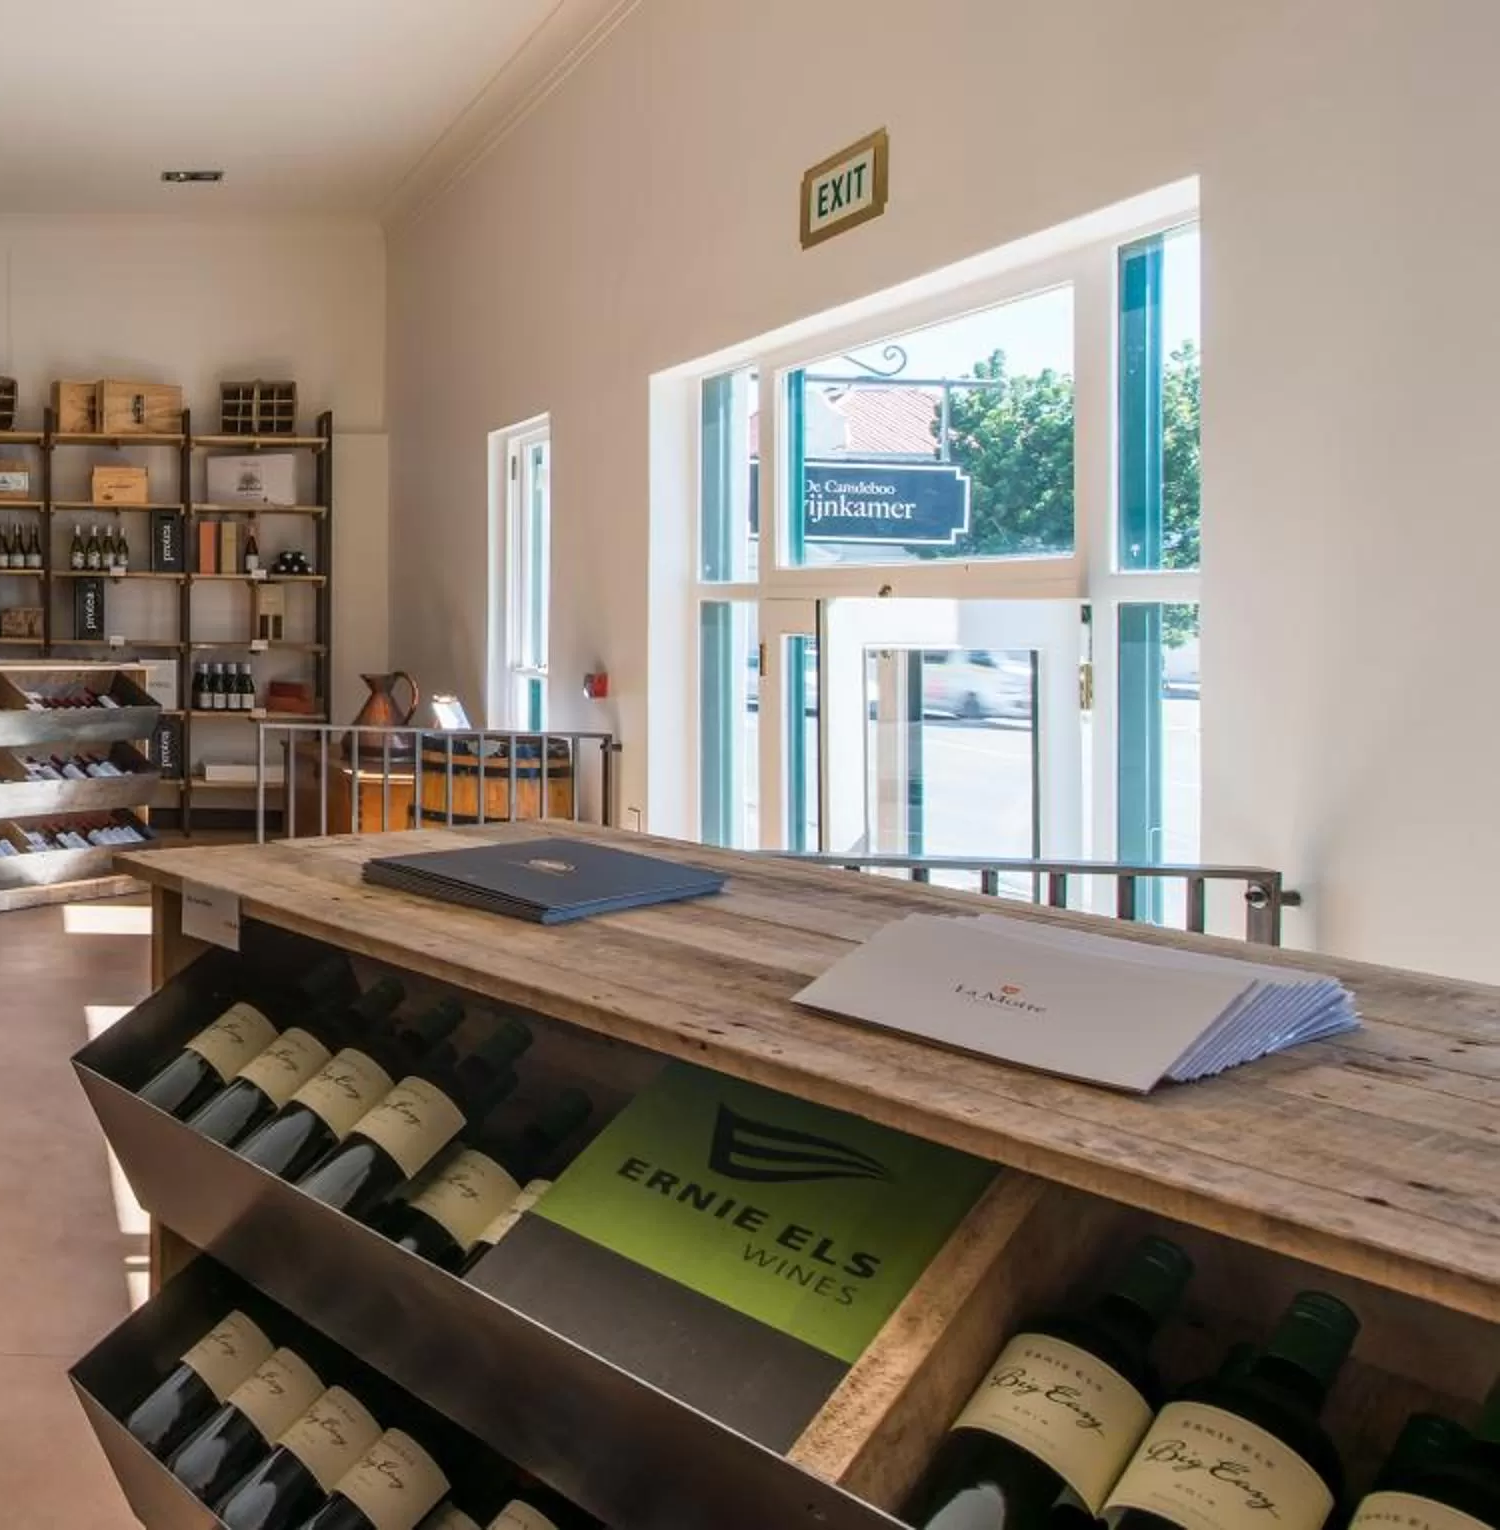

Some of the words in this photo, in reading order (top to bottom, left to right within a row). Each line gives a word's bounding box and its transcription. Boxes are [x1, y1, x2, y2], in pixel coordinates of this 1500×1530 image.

[817, 162, 867, 218] EXIT
[804, 493, 917, 523] ijnkamer
[616, 1156, 770, 1233] ERNIE
[775, 1223, 882, 1280] ELS
[742, 1241, 860, 1307] WINES
[989, 1366, 1040, 1398] Big
[1044, 1384, 1106, 1439] Easy
[1143, 1439, 1204, 1473] Big
[1208, 1457, 1283, 1521] Easy
